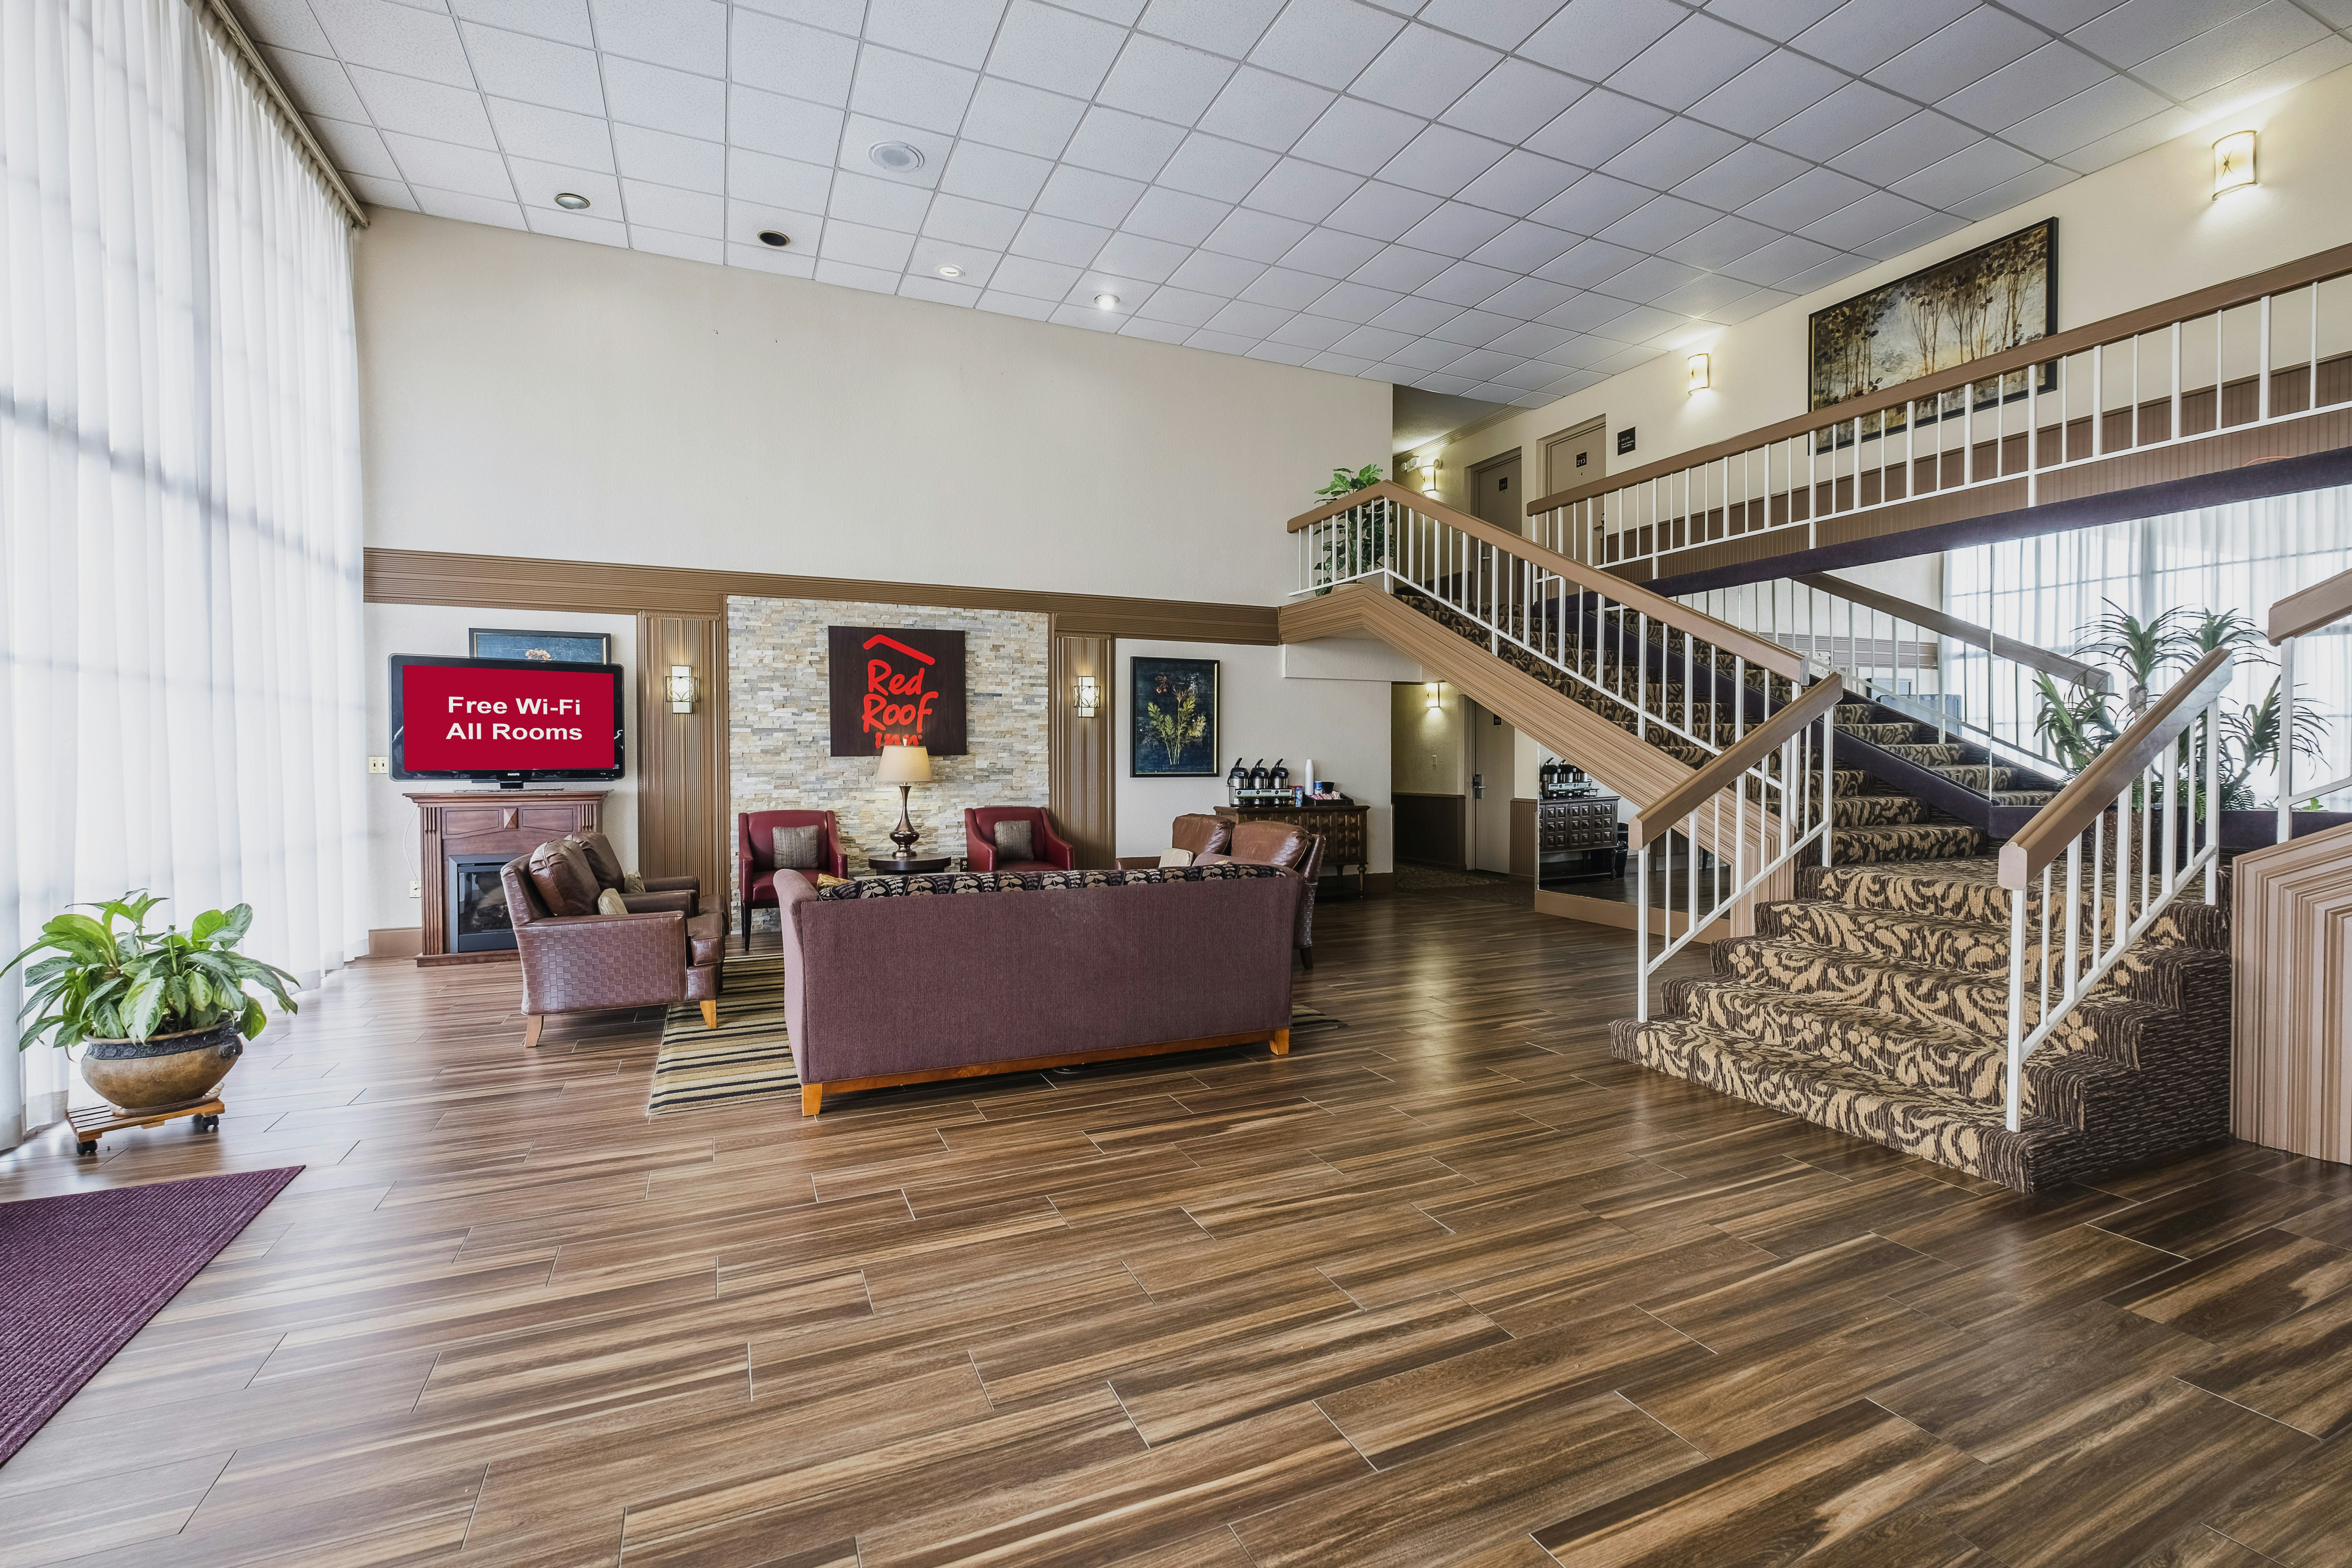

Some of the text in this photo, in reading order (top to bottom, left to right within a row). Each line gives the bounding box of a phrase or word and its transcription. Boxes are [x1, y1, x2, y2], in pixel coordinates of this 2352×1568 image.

[868, 659, 925, 696] Red
[448, 696, 580, 715] Free Wi-Fi
[862, 691, 939, 733] Roof
[446, 723, 582, 740] All Rooms
